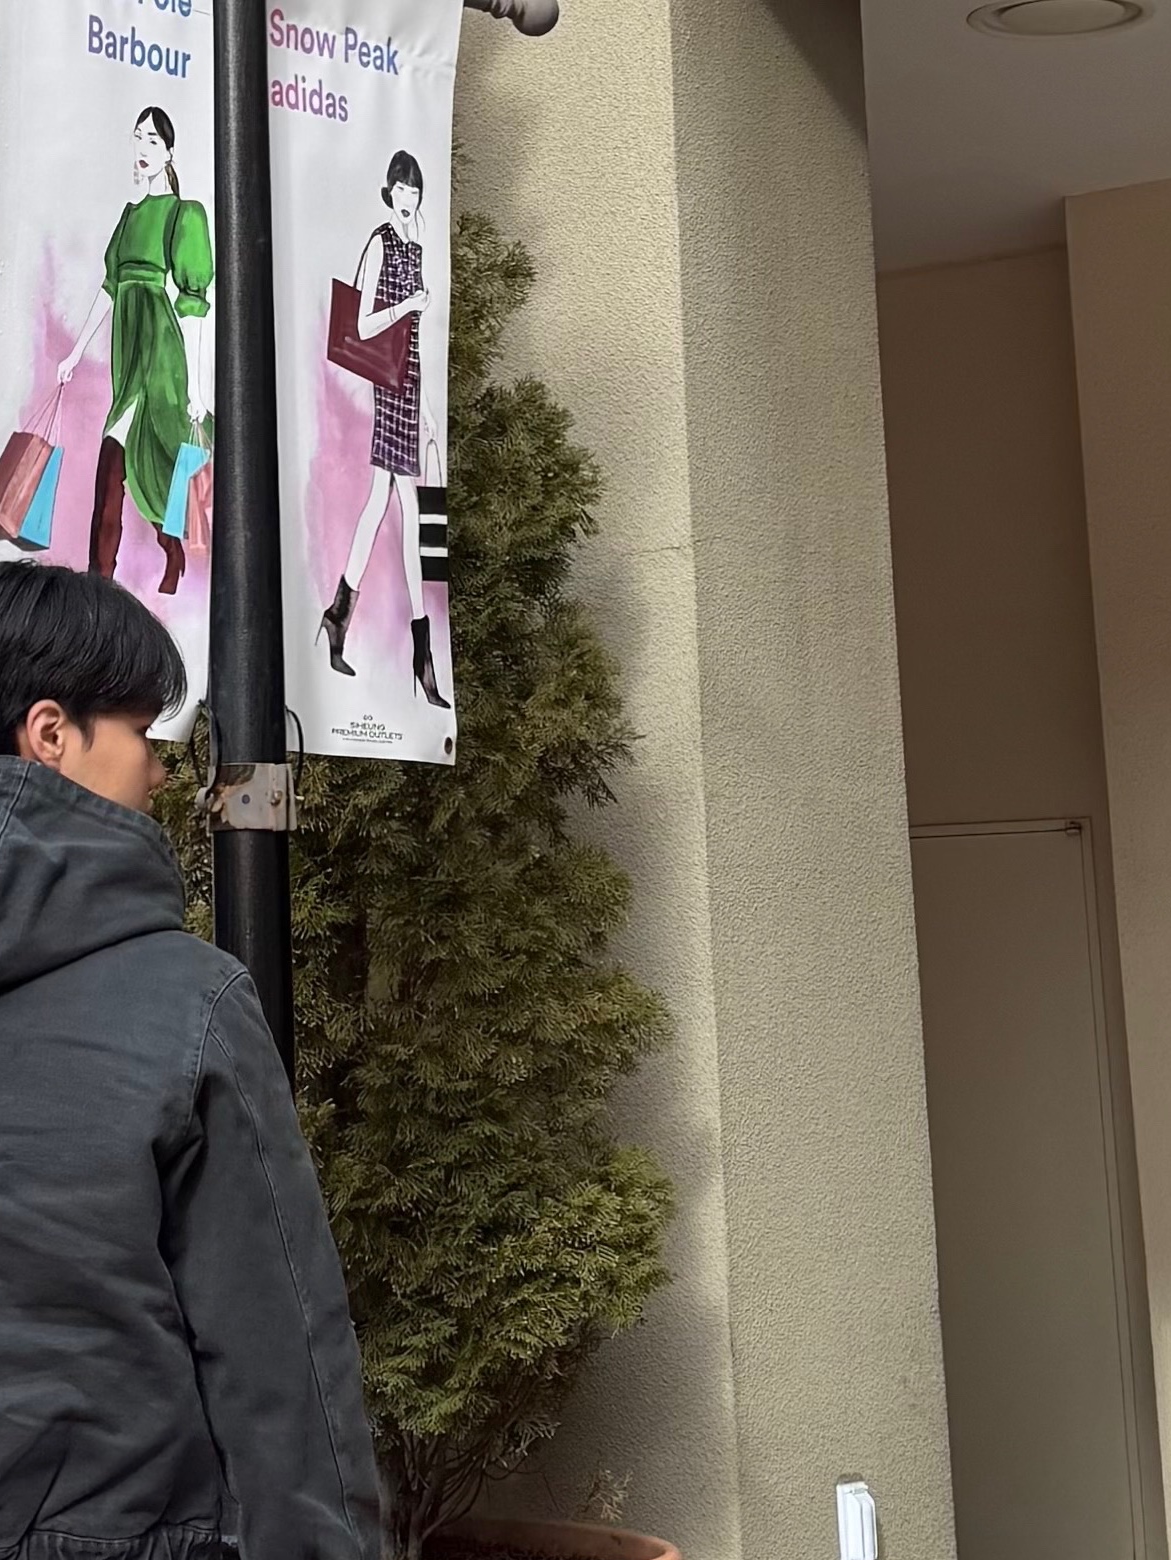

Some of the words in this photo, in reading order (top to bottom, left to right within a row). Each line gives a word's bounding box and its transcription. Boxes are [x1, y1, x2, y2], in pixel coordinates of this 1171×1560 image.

[88, 14, 191, 79] Barbour
[270, 9, 336, 59] Snow
[344, 26, 399, 75] Peak
[271, 73, 348, 122] adidas
